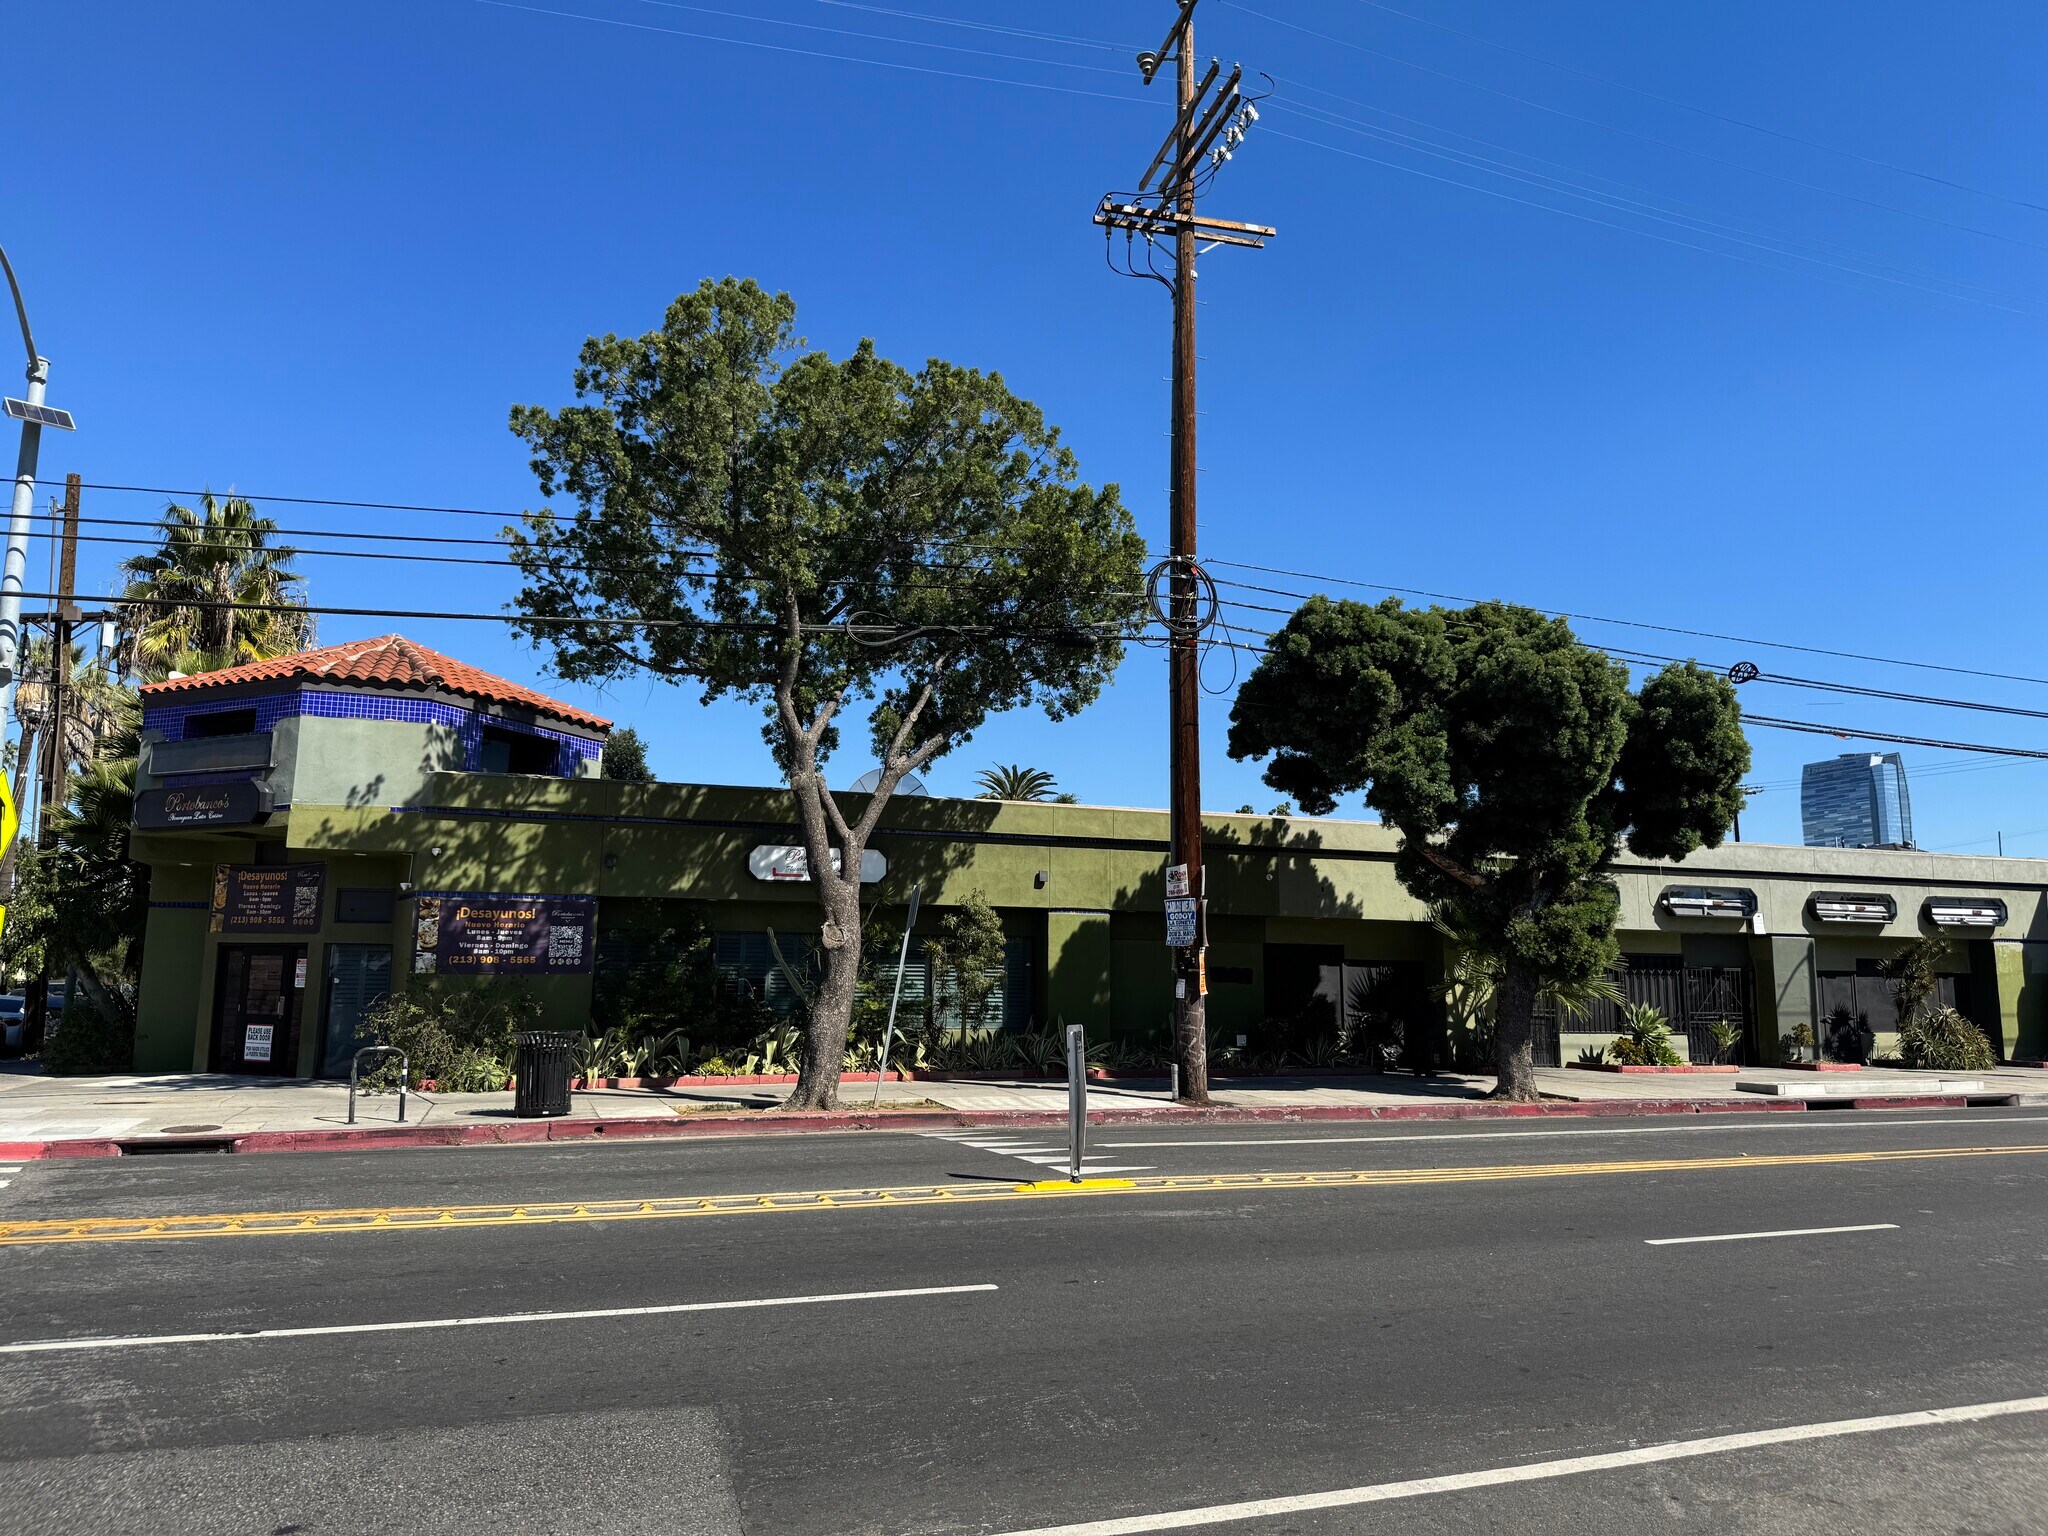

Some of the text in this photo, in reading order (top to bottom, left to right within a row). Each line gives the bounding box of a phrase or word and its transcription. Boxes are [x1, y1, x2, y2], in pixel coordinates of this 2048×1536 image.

[165, 793, 229, 812] Portobanco's
[238, 871, 288, 882] ¡Desayunos!
[456, 907, 536, 921] ¡Desayunos!
[449, 956, 476, 964] (213)
